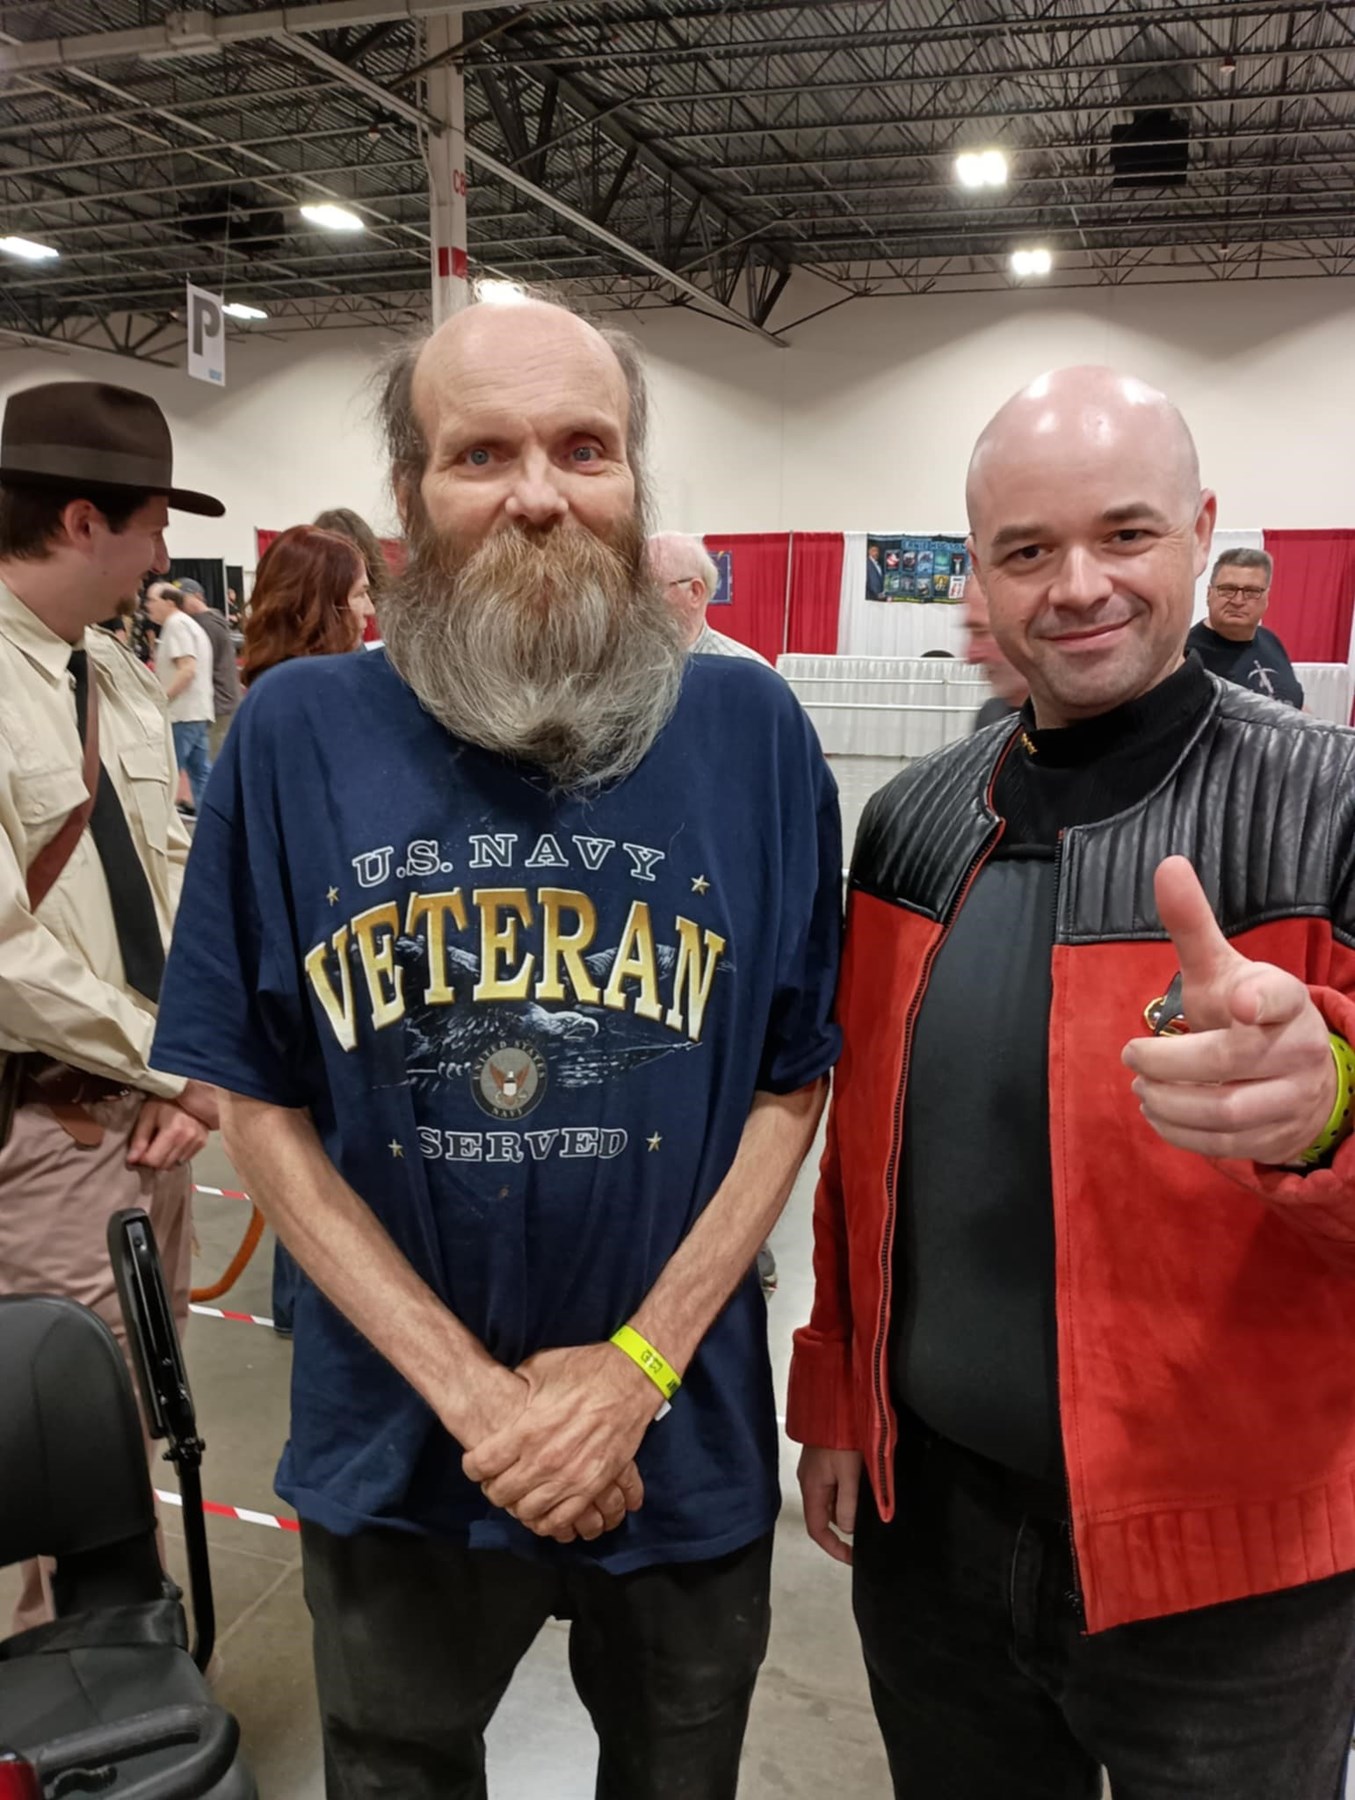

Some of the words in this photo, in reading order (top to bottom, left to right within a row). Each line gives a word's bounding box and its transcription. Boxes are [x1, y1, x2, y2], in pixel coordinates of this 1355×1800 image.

[193, 294, 221, 356] P
[352, 840, 453, 887] U.S.
[469, 834, 665, 881] NAVY
[305, 887, 726, 1052] VETERAN
[416, 1126, 628, 1163] SERVED
